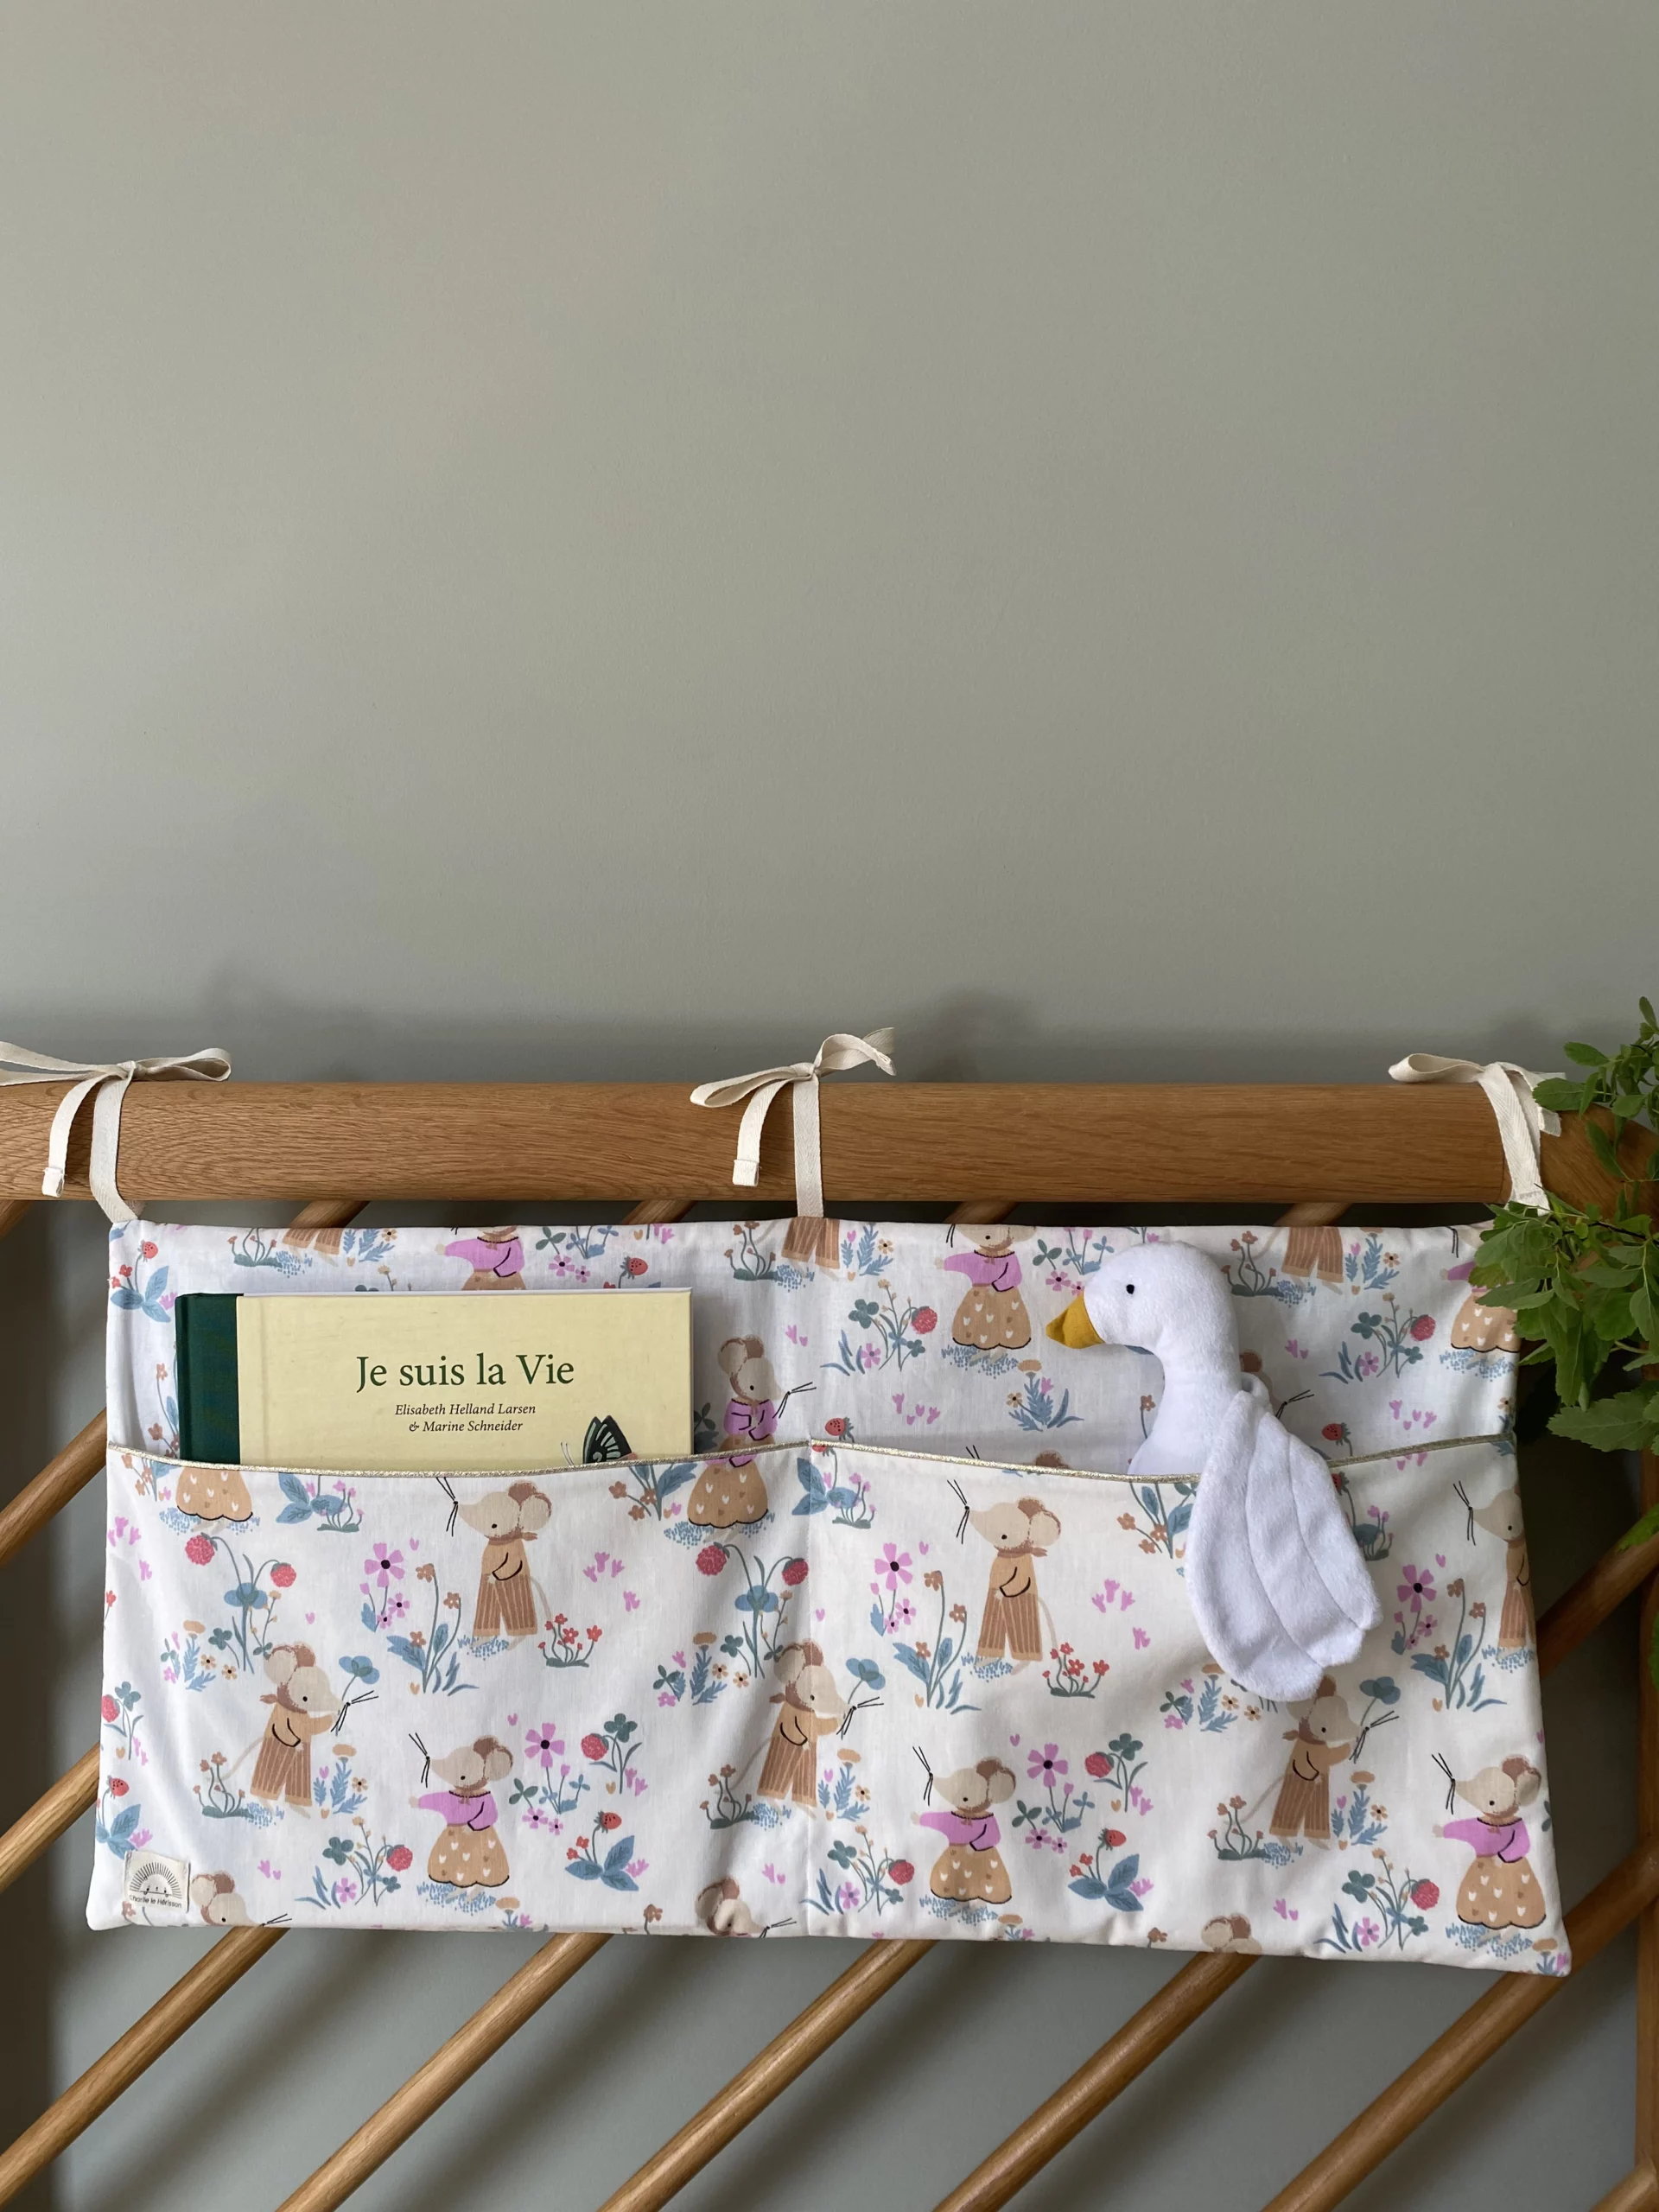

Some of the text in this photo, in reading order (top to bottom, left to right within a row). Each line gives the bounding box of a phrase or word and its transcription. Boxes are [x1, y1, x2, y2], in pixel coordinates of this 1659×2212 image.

[356, 1352, 575, 1394] Je suis la Vie
[395, 1402, 537, 1415] Elisabeth Helland Larsen
[409, 1420, 524, 1432] & Marine Schneider
